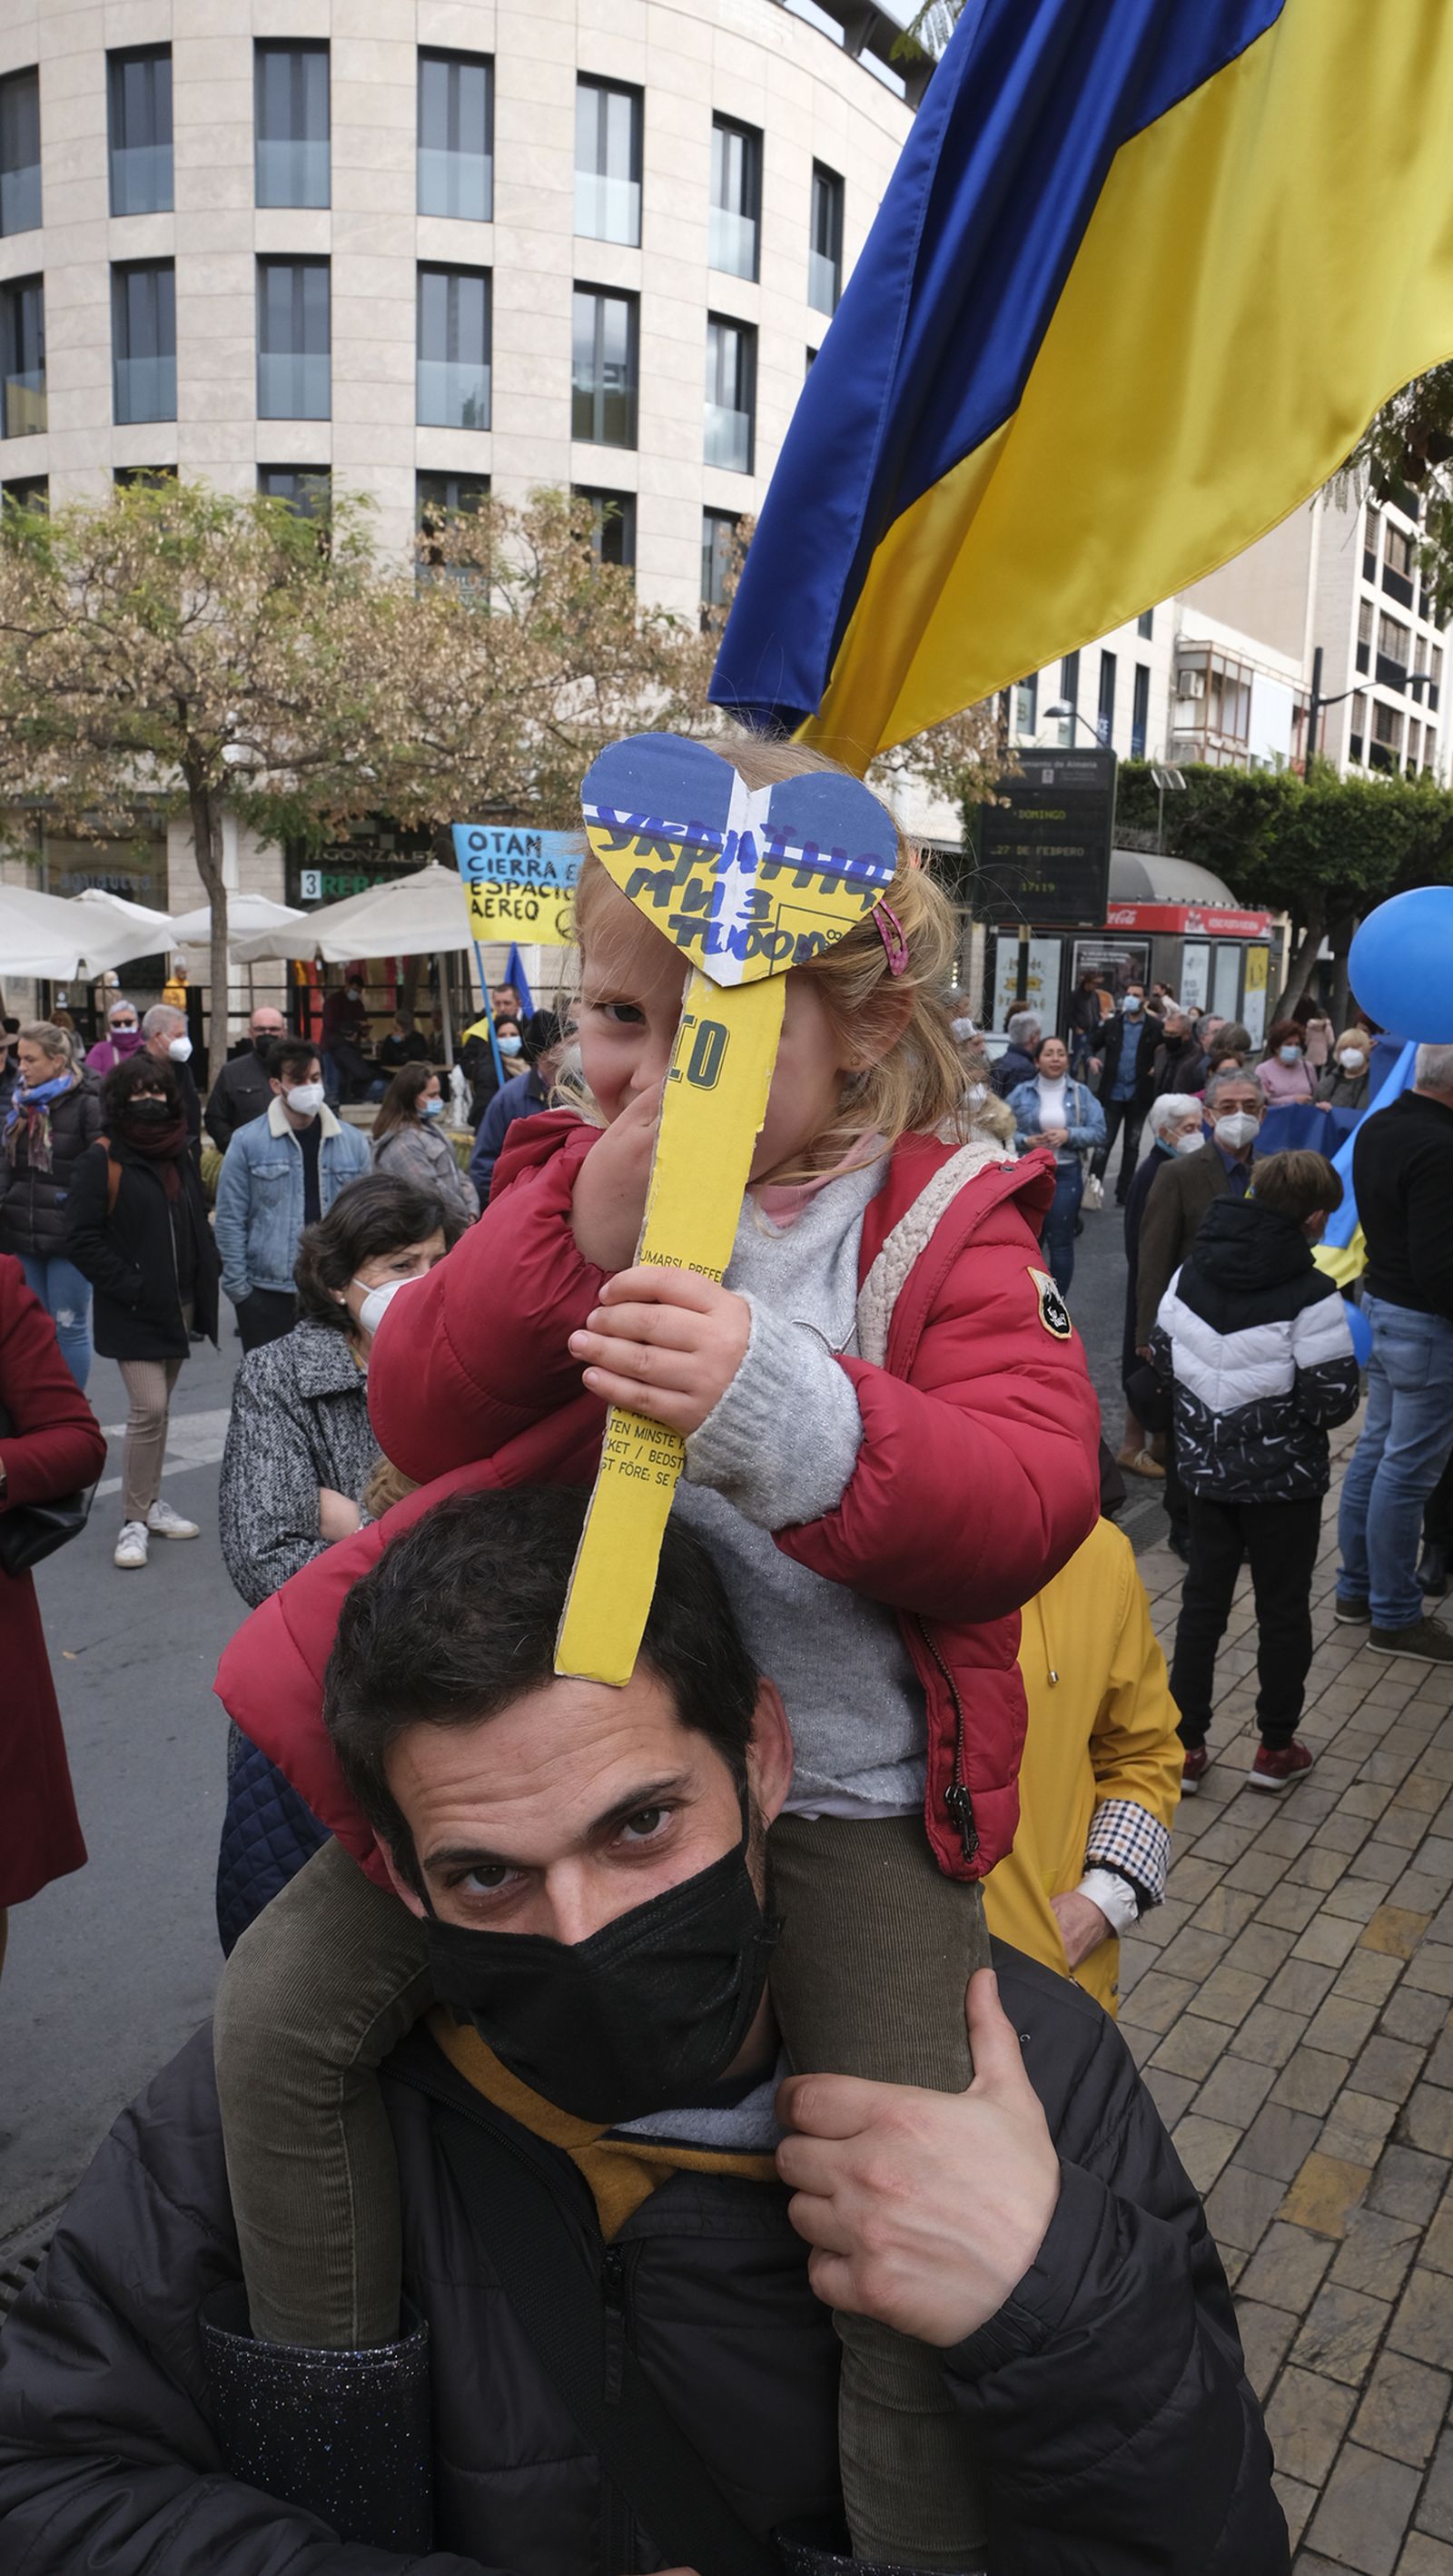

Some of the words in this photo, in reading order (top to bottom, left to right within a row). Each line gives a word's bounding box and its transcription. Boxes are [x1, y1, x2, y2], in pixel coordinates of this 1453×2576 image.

[1018, 809, 1066, 821] DOMINGO
[468, 831, 542, 858] OTAN
[1016, 845, 1030, 856] DE
[467, 856, 557, 879] CIERRA
[566, 863, 578, 882] E
[306, 873, 316, 894] 3
[1022, 883, 1055, 893] 17:19
[471, 898, 539, 921] AEREO
[687, 1262, 724, 1284] PREFE
[609, 1418, 631, 1435] TEN
[634, 1426, 676, 1447] MINSTE
[607, 1437, 630, 1455] KET
[635, 1446, 644, 1459] /
[648, 1450, 684, 1469] BEDST
[655, 1472, 670, 1486] SE
